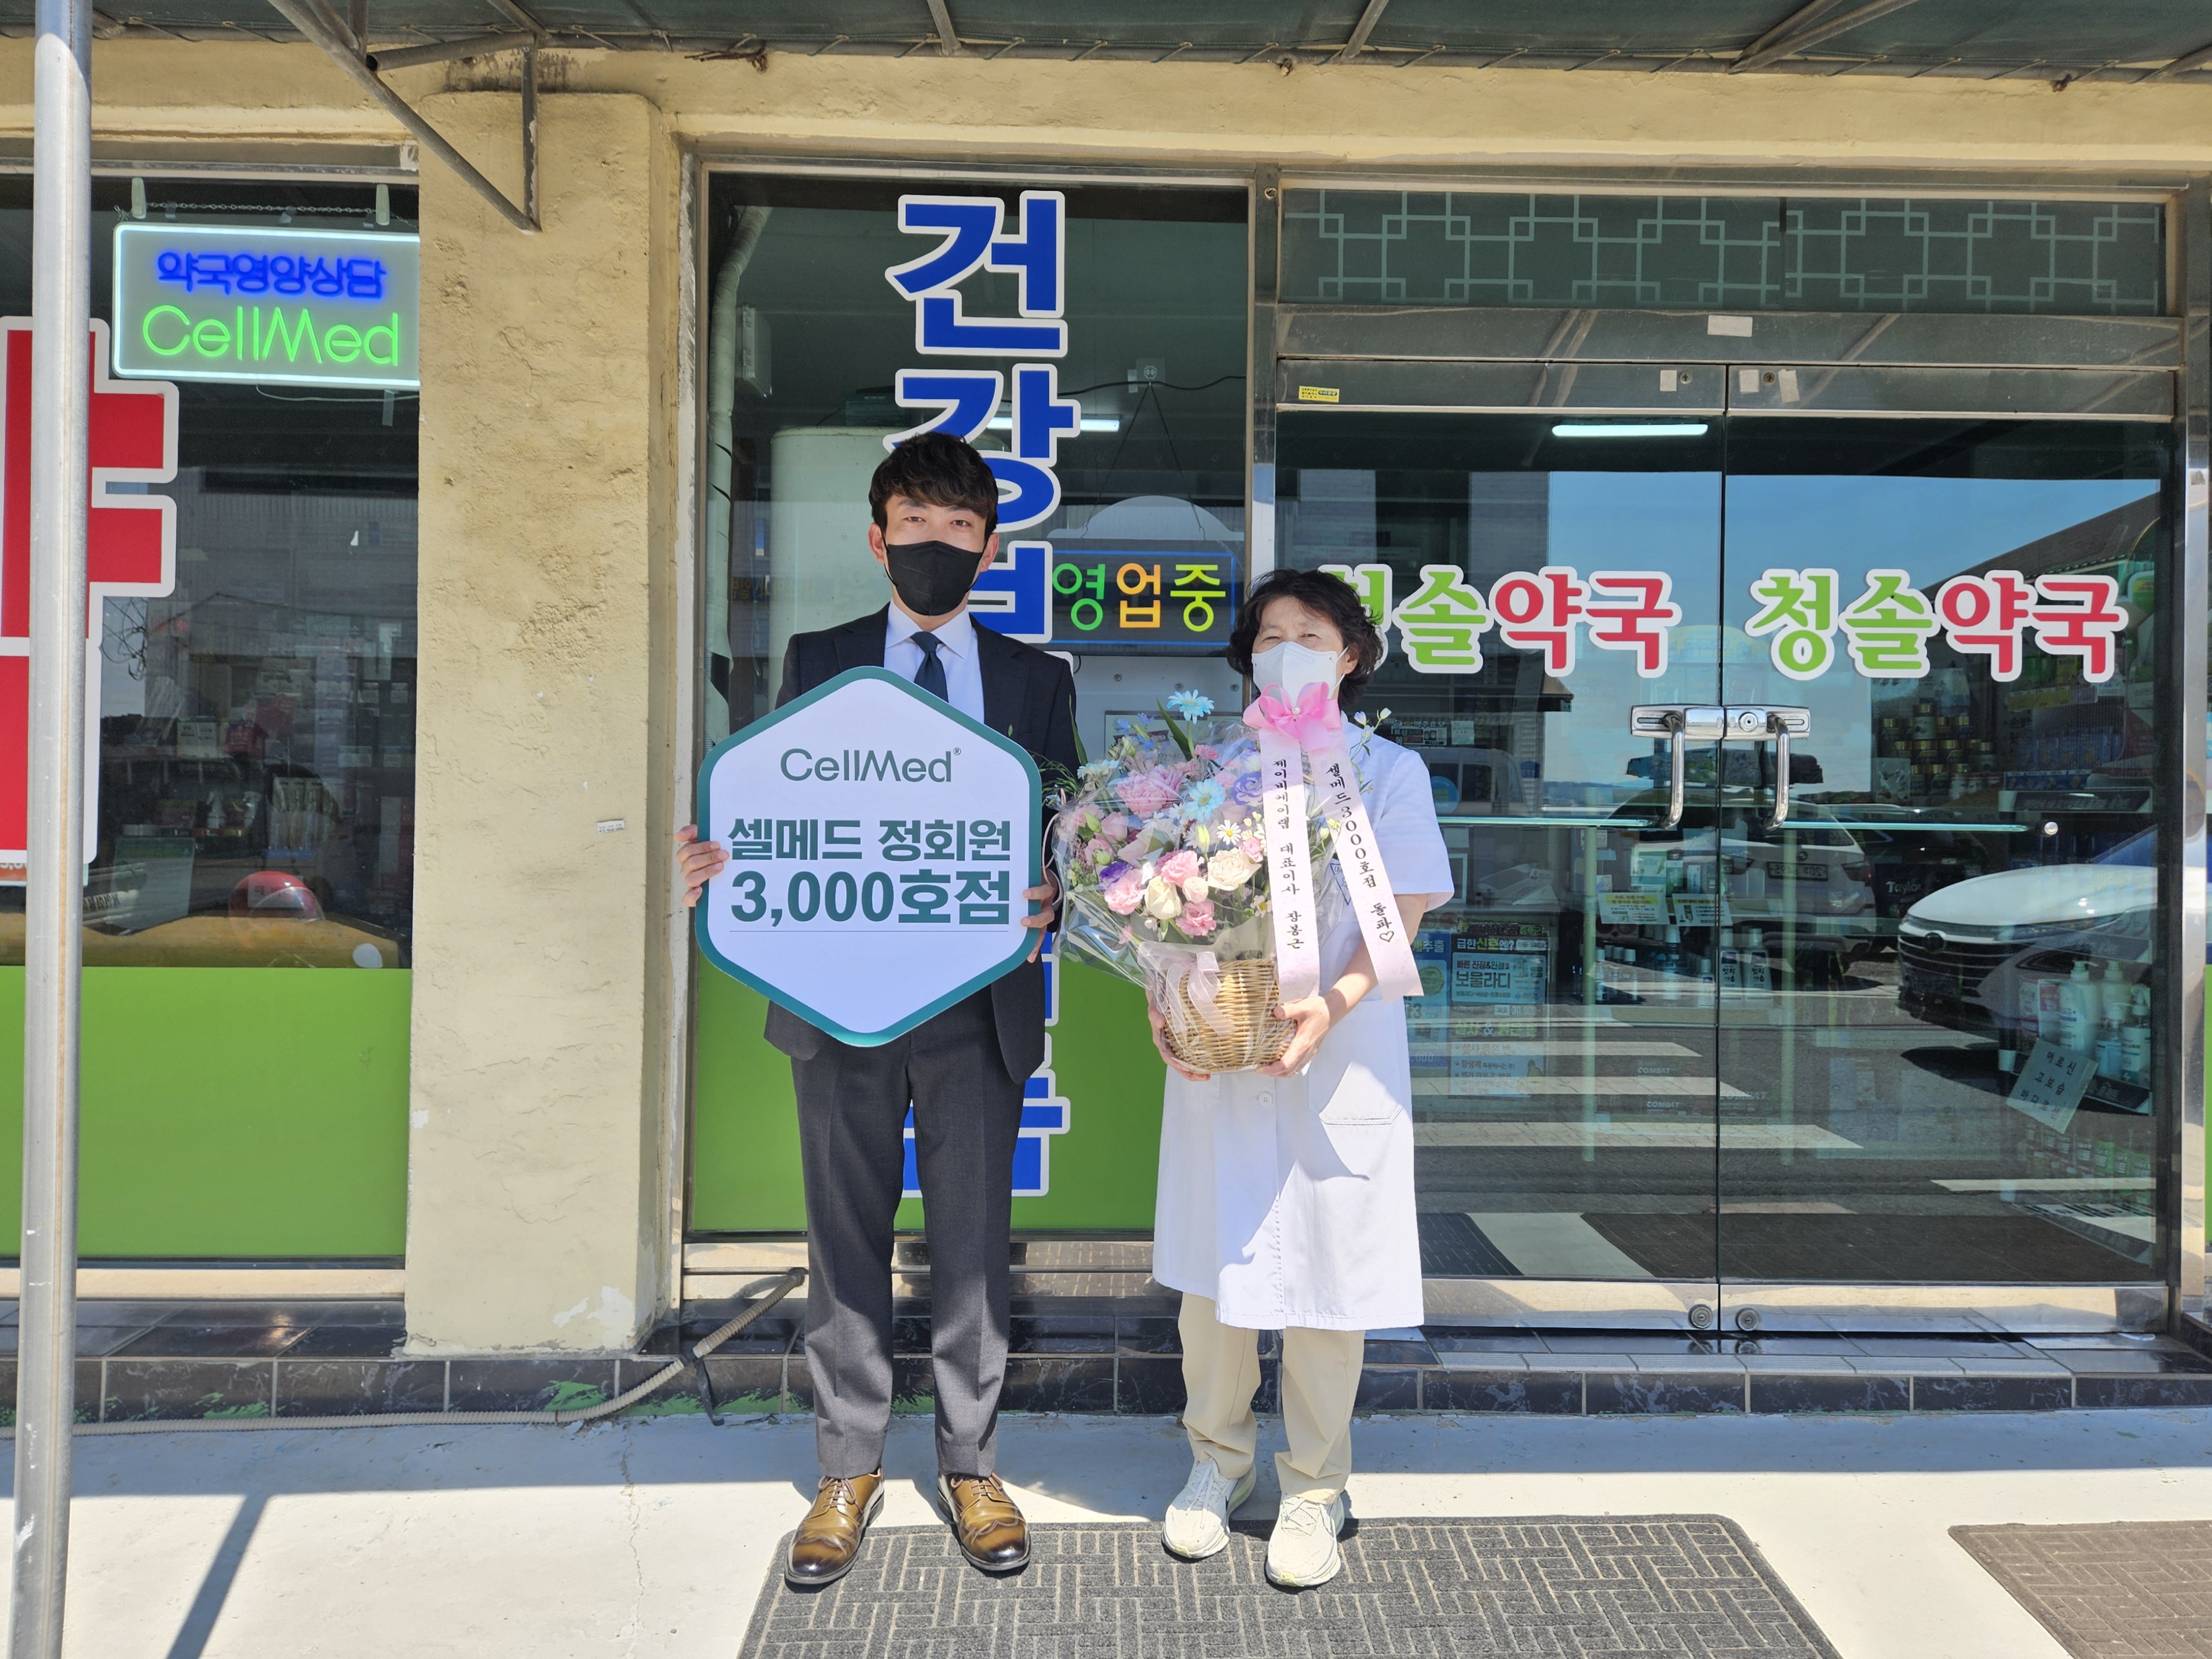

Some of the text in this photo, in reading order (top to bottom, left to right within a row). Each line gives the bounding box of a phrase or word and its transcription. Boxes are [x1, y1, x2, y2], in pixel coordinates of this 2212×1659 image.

[158, 251, 386, 299] 약국영양상담
[142, 305, 399, 366] CellMed
[1052, 561, 1226, 632] 영업중
[1751, 574, 2121, 677] 청솔약국
[727, 817, 1011, 862] 셀메드 정회원
[1273, 759, 1305, 949] 제이비케이랩 대표이사 장봉근
[730, 868, 1010, 928] 3,000호점
[1456, 970, 1511, 989] 보울라디
[2035, 1071, 2066, 1096] 고보습
[2046, 1051, 2077, 1076] 어르신
